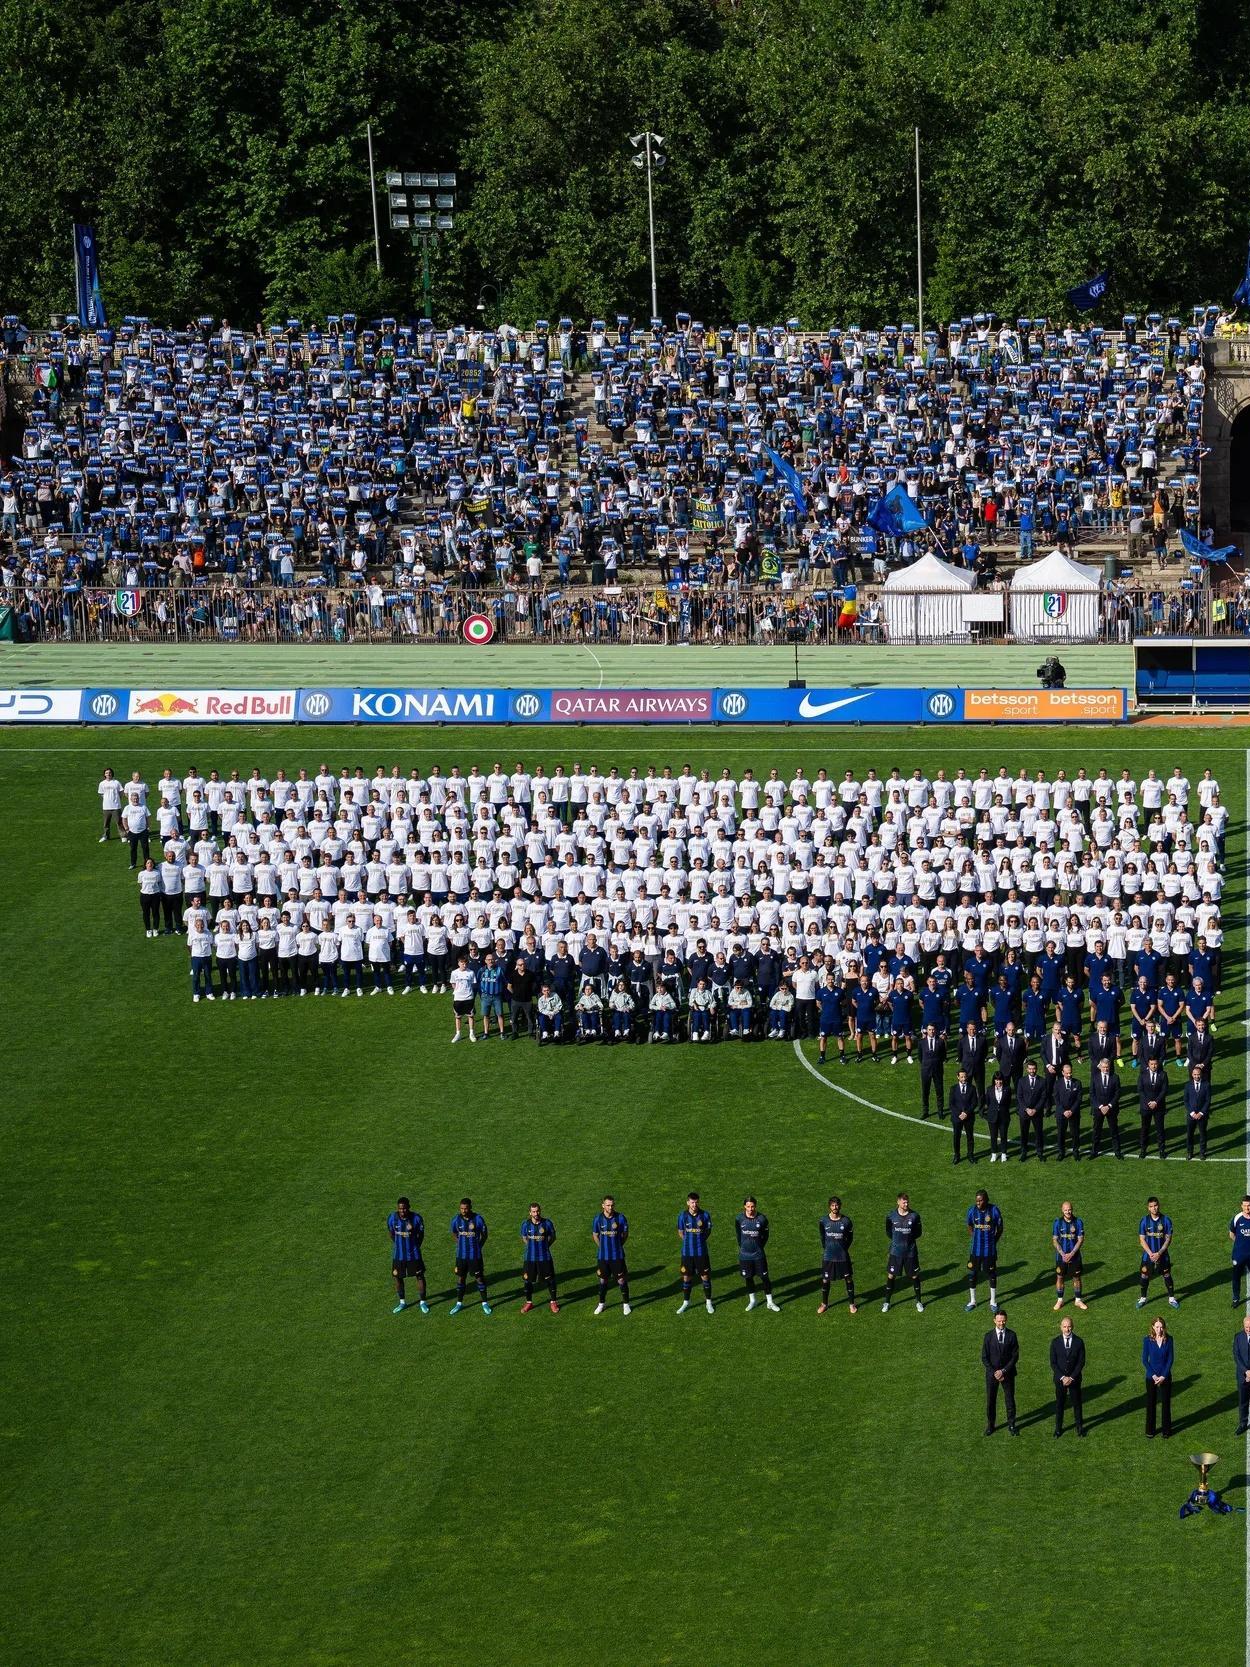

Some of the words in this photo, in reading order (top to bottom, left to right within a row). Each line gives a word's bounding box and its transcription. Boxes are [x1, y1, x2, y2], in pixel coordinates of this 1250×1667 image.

[121, 592, 136, 610] 21
[1048, 596, 1061, 612] 21
[207, 696, 247, 715] Red
[251, 696, 291, 715] Bull
[352, 693, 494, 717] KONAMI
[555, 697, 621, 716] QATAR
[625, 697, 708, 713] AIRWAYS
[970, 692, 1038, 705] betsson
[1049, 692, 1117, 705] betsson
[1001, 704, 1038, 718] .sport
[1080, 704, 1117, 718] .sport
